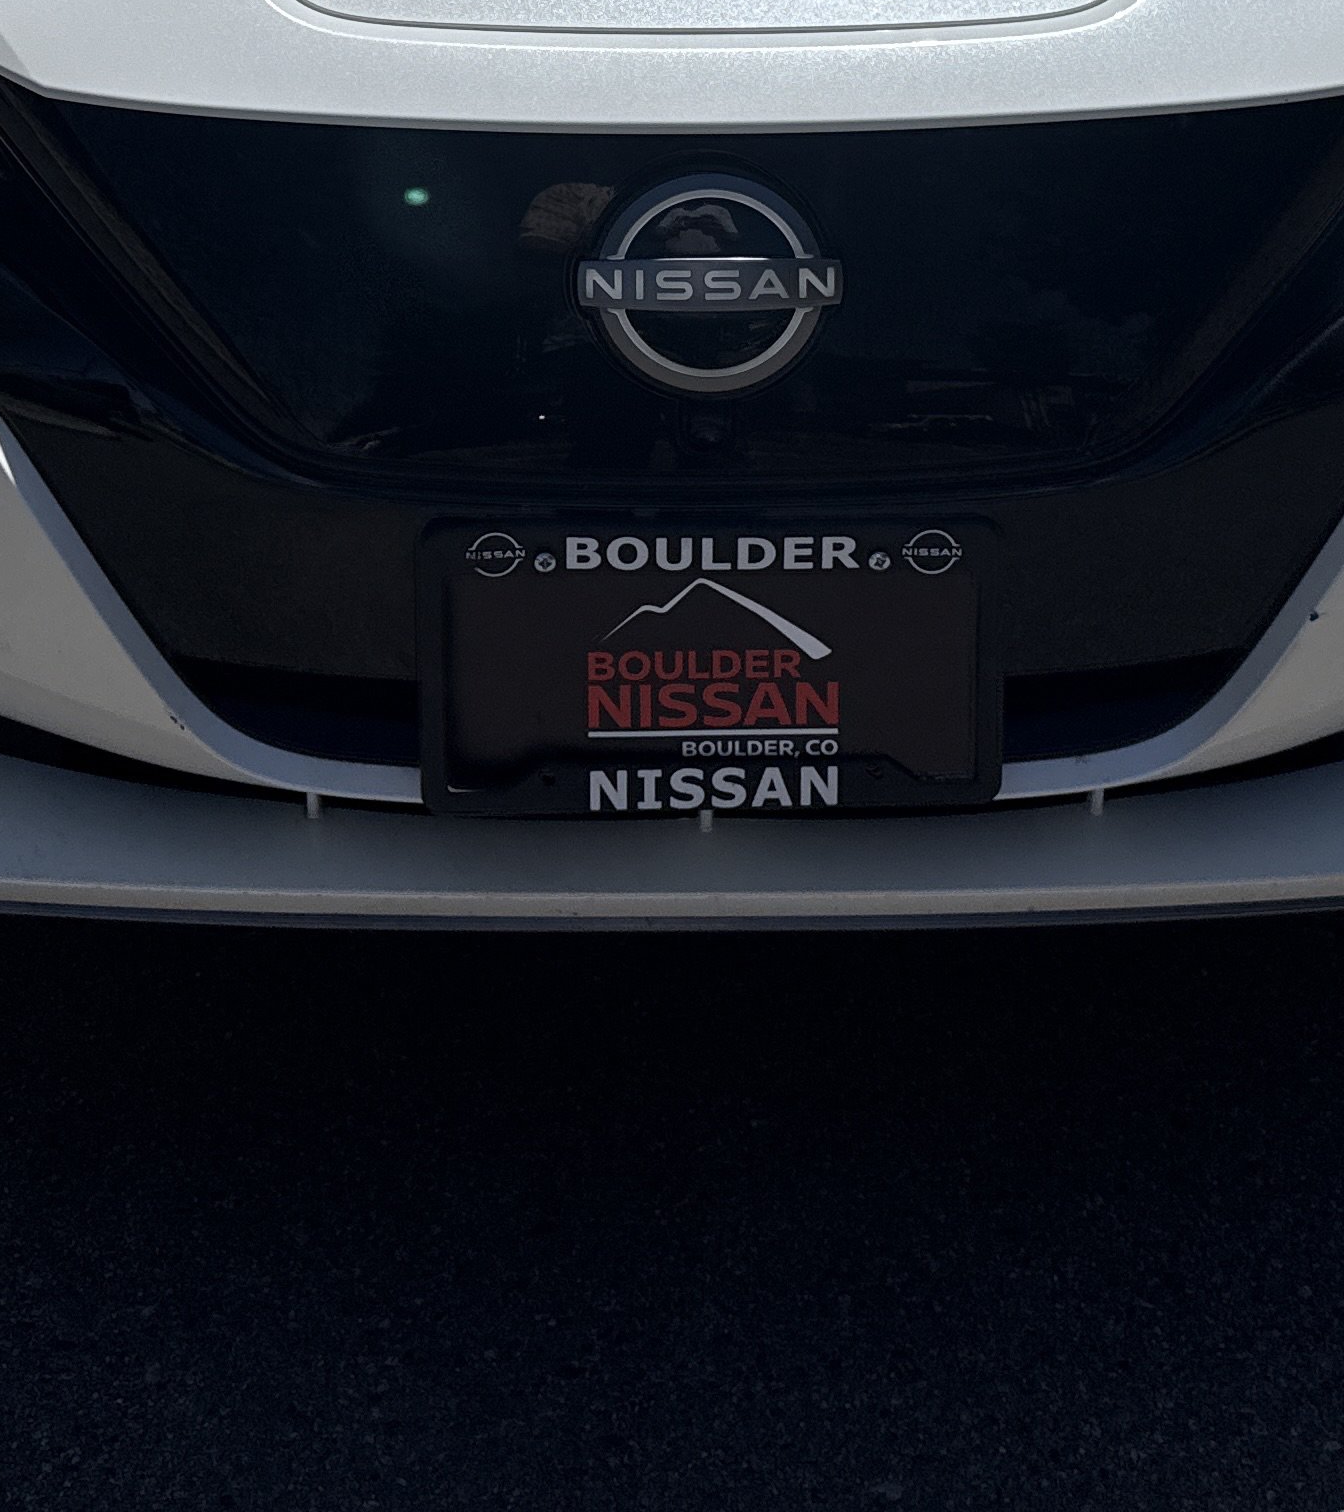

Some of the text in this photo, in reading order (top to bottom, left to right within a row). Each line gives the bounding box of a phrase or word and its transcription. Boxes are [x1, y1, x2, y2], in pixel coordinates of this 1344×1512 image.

[585, 268, 835, 301] NISSAN
[465, 549, 526, 560] NISSAN
[565, 535, 860, 572] BOULDER
[902, 546, 963, 557] NISSAN
[587, 649, 801, 682] BOULDER
[587, 681, 840, 729] NISSAN
[681, 738, 840, 758] BOULDER, CO
[588, 765, 840, 811] NISSAN
